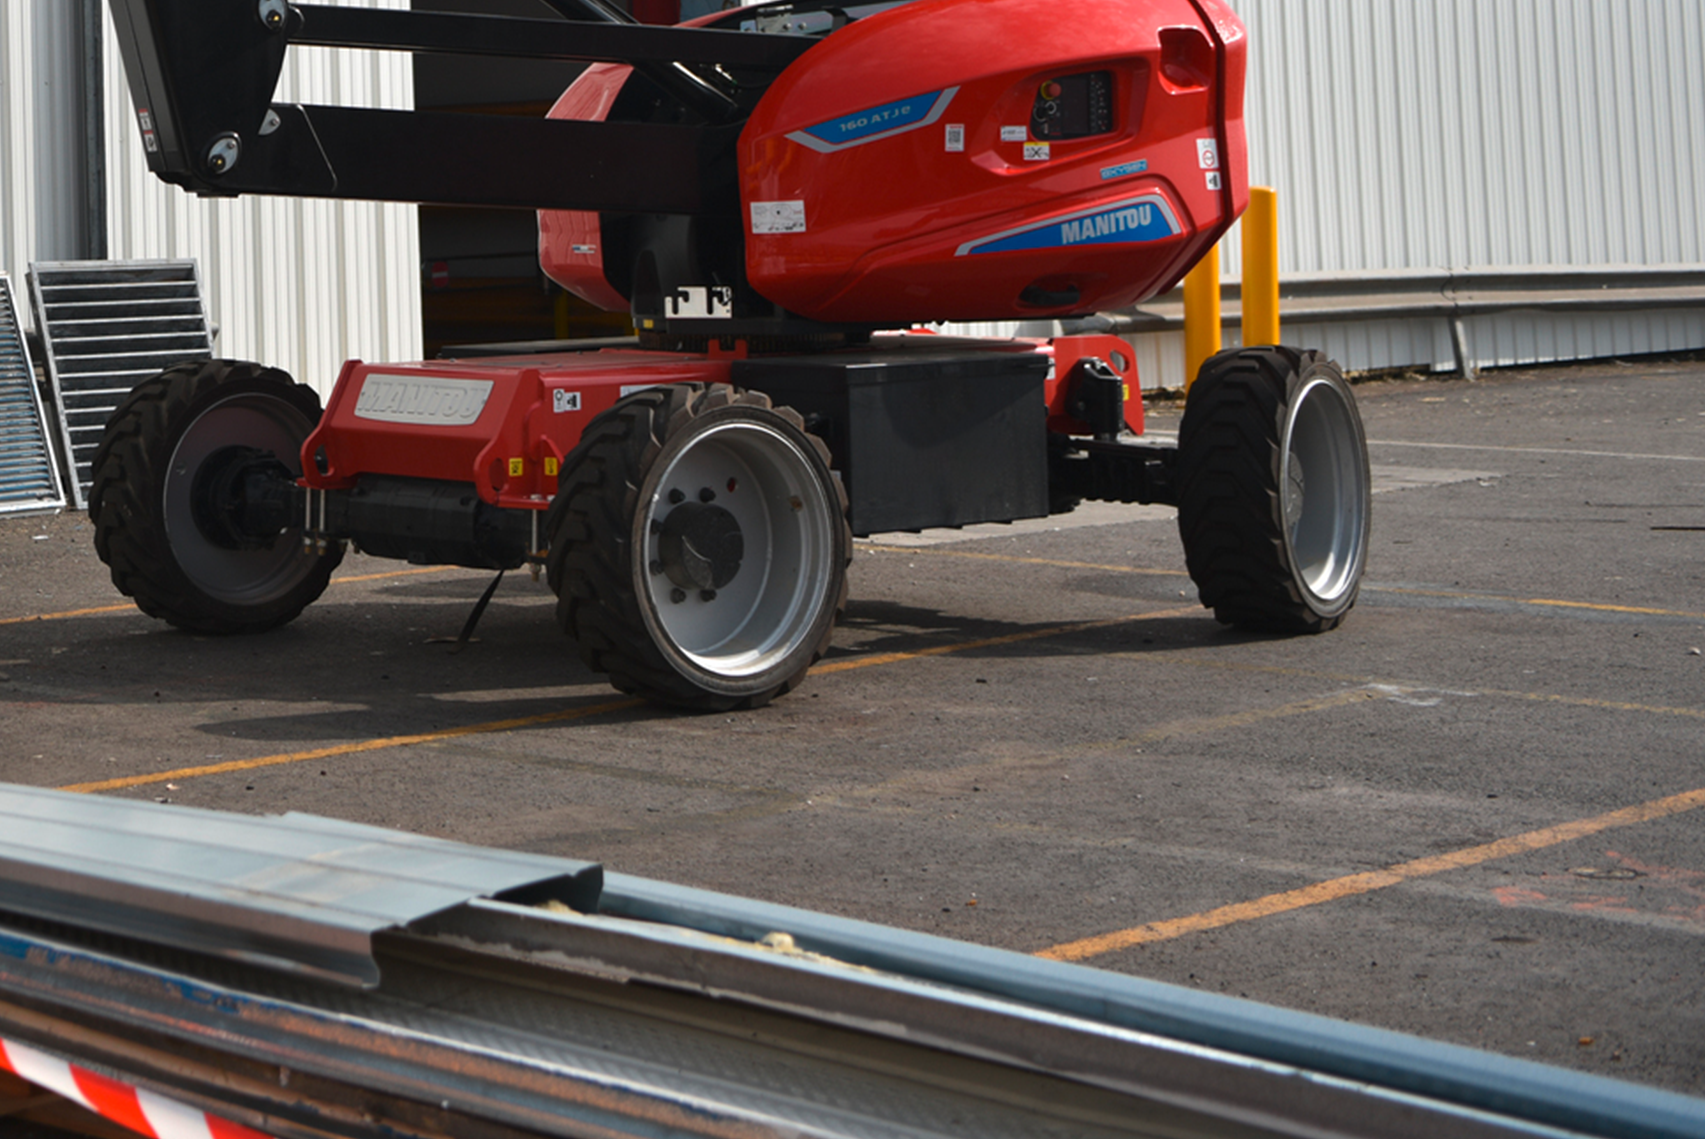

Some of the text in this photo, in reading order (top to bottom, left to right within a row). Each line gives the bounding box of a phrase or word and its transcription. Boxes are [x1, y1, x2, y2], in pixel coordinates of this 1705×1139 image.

[839, 118, 867, 131] 160
[1061, 205, 1152, 244] MANITOU
[357, 381, 488, 418] MANITOU
